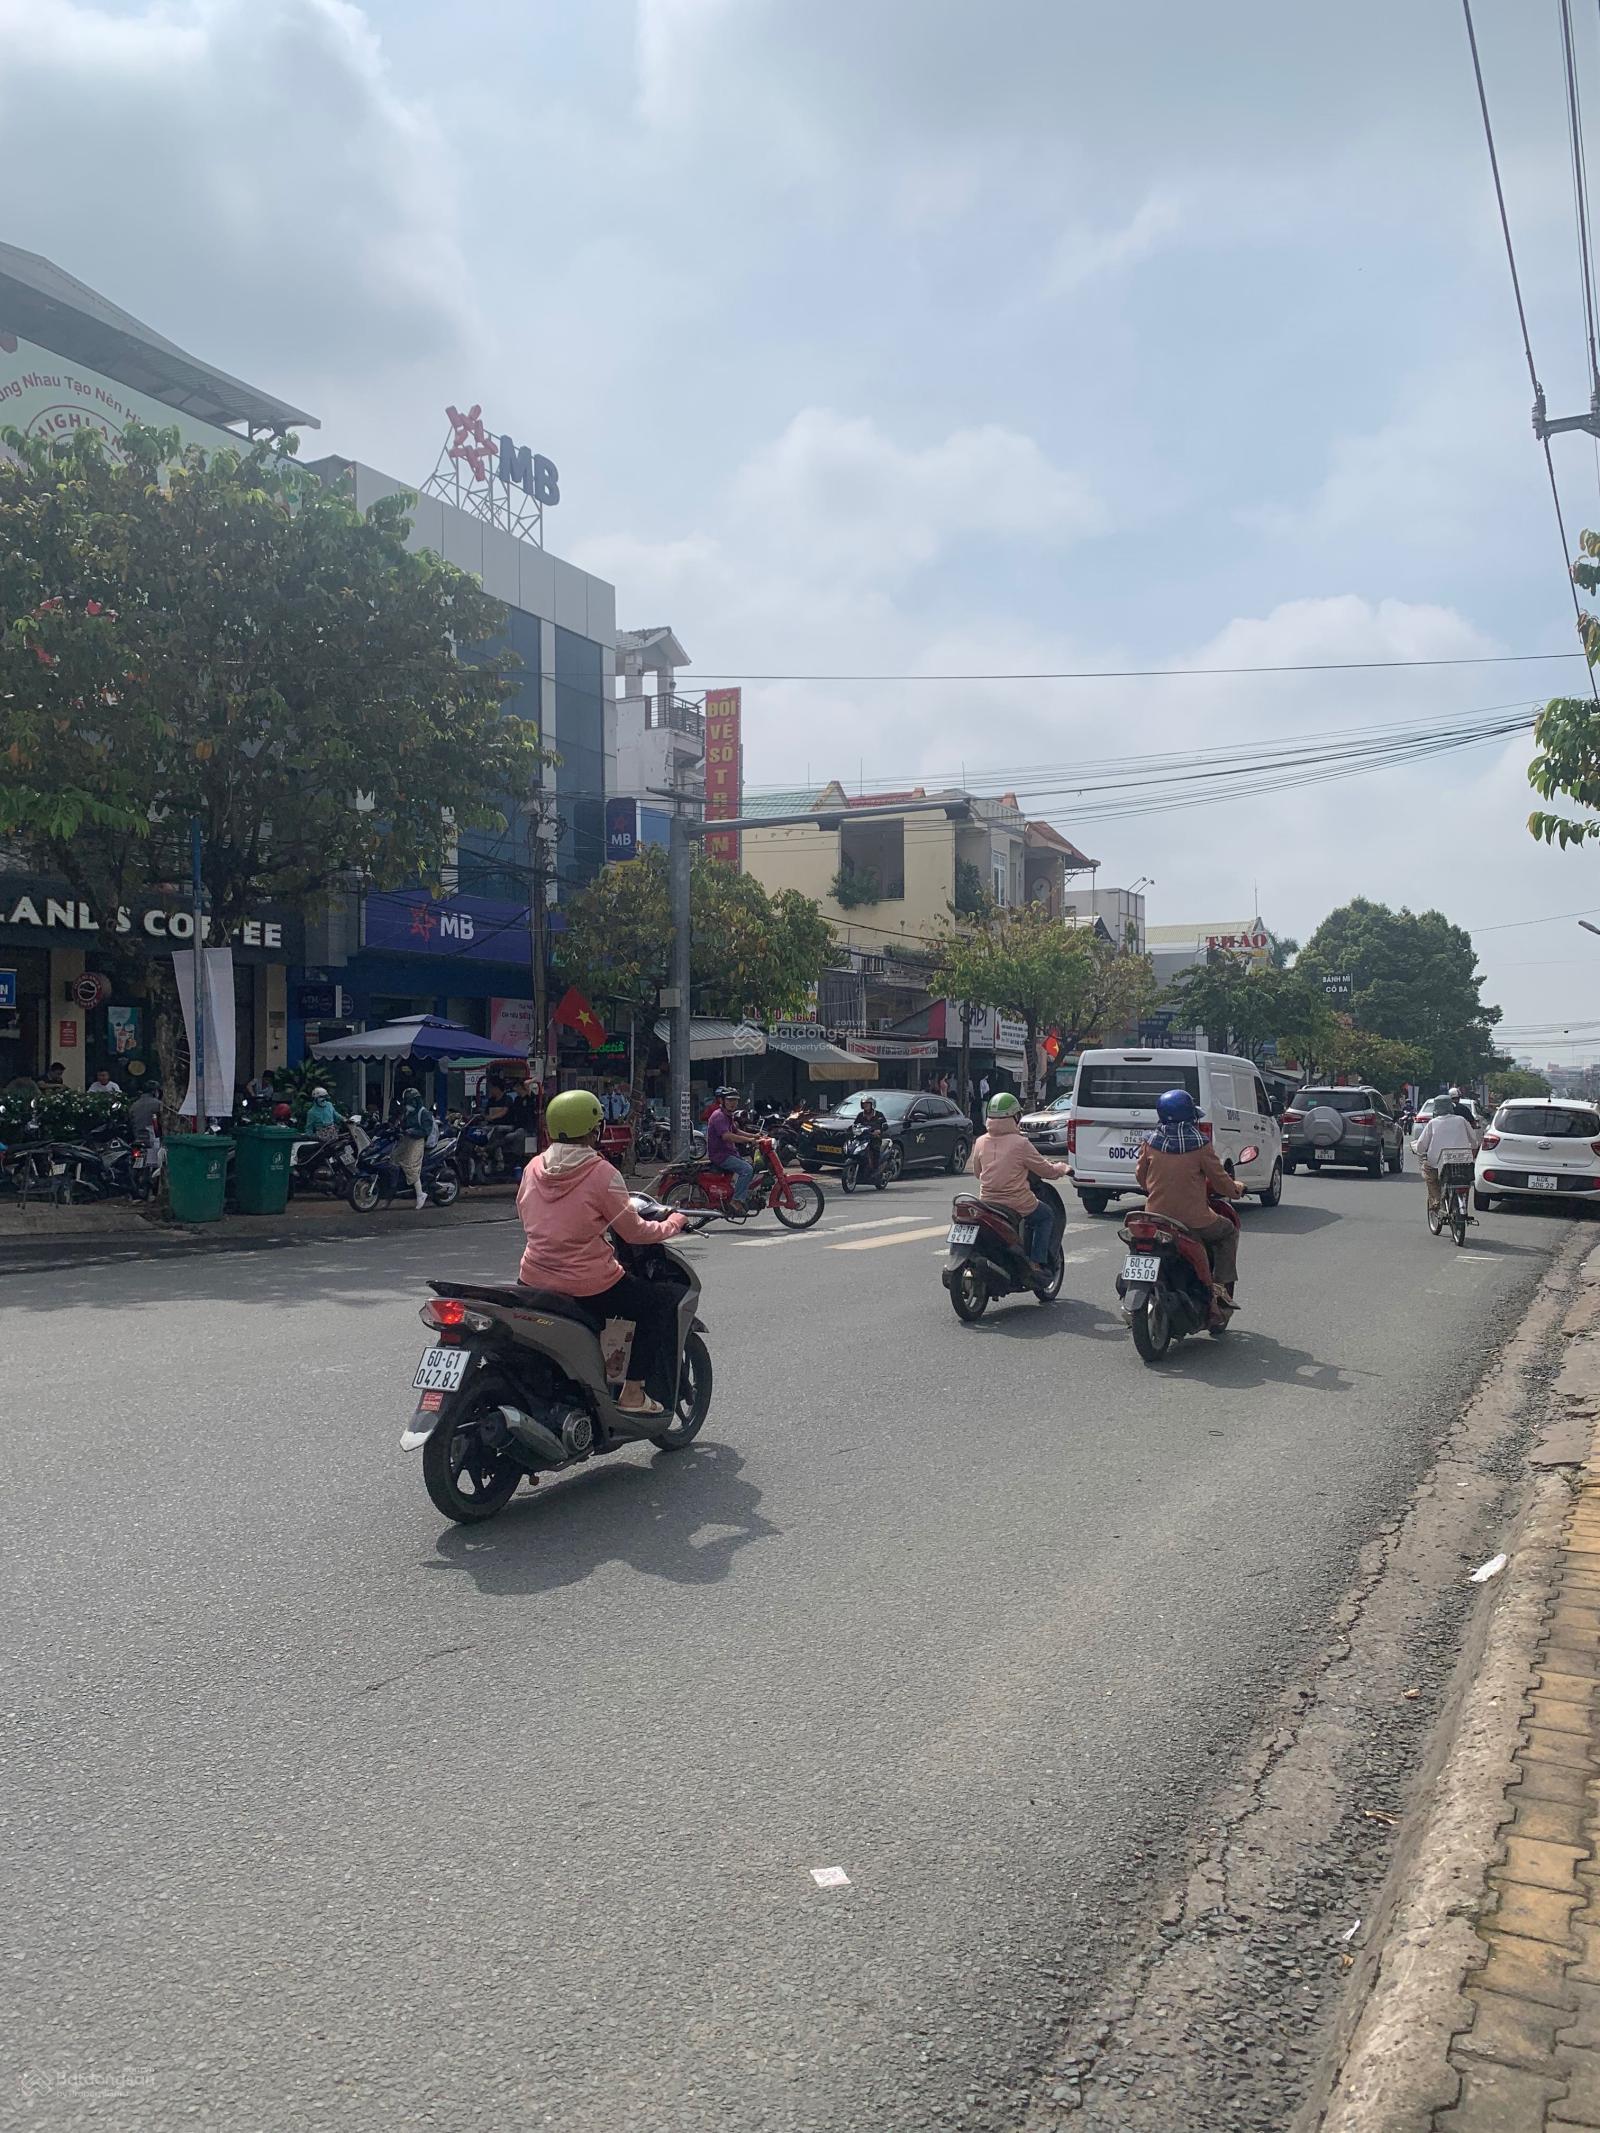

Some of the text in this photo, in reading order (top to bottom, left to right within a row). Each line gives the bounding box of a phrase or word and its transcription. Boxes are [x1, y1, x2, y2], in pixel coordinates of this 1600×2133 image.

[22, 372, 61, 389] Nhau
[64, 375, 91, 395] Tạo
[499, 434, 560, 506] MB
[710, 719, 732, 740] VÉ
[709, 740, 733, 763] SỐ
[611, 832, 631, 846] MB
[440, 912, 475, 940] MB
[1205, 931, 1268, 949] THẢO
[1322, 974, 1341, 983] BÁNH
[1326, 984, 1348, 993] CÔ BA
[1124, 1268, 1156, 1280] 655.09
[427, 1350, 461, 1369] 60-G1
[416, 1368, 459, 1389] 047.82
